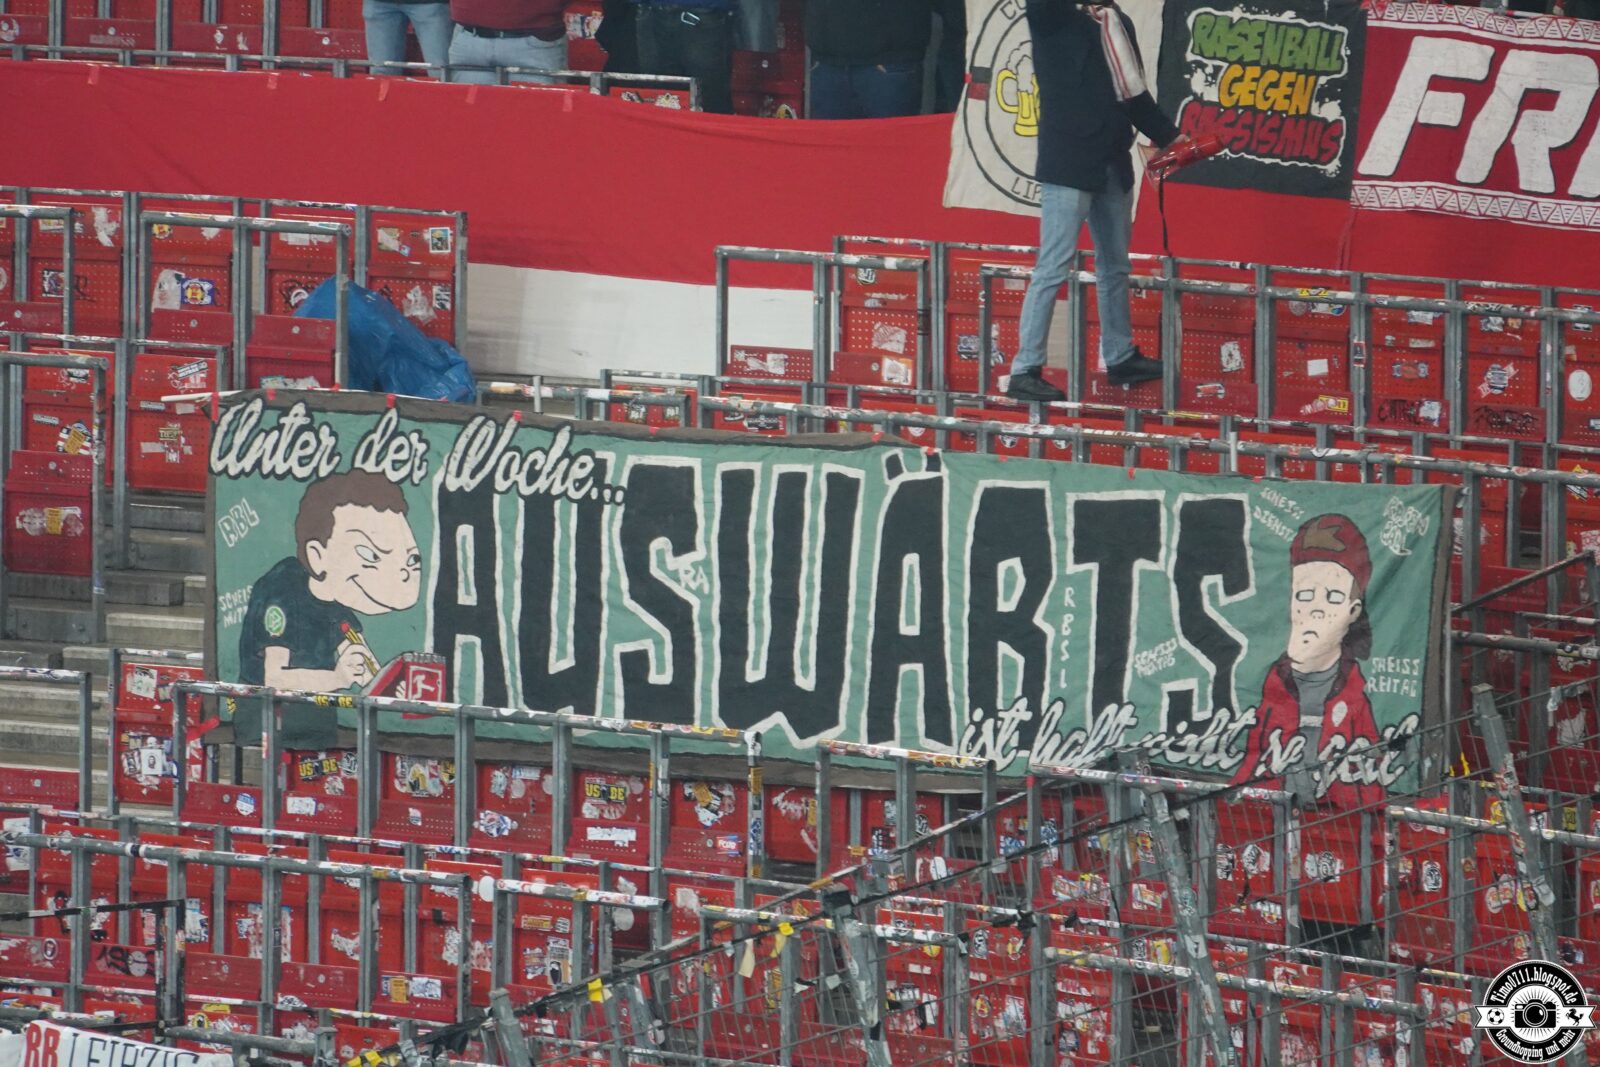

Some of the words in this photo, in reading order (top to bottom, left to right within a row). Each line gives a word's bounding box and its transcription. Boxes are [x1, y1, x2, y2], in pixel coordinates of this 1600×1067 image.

[1192, 14, 1344, 71] RASENBALL
[1219, 64, 1317, 116] GEGEN
[1180, 101, 1343, 162] RASSISMUS
[1010, 176, 1042, 201] LIP
[209, 398, 341, 479] Unter
[353, 405, 428, 485] der
[445, 414, 625, 503] Woche...
[218, 497, 260, 547] RBL
[426, 446, 1257, 751] AUSWÄRTS
[960, 697, 1033, 769] ist
[24, 1022, 61, 1067] RB
